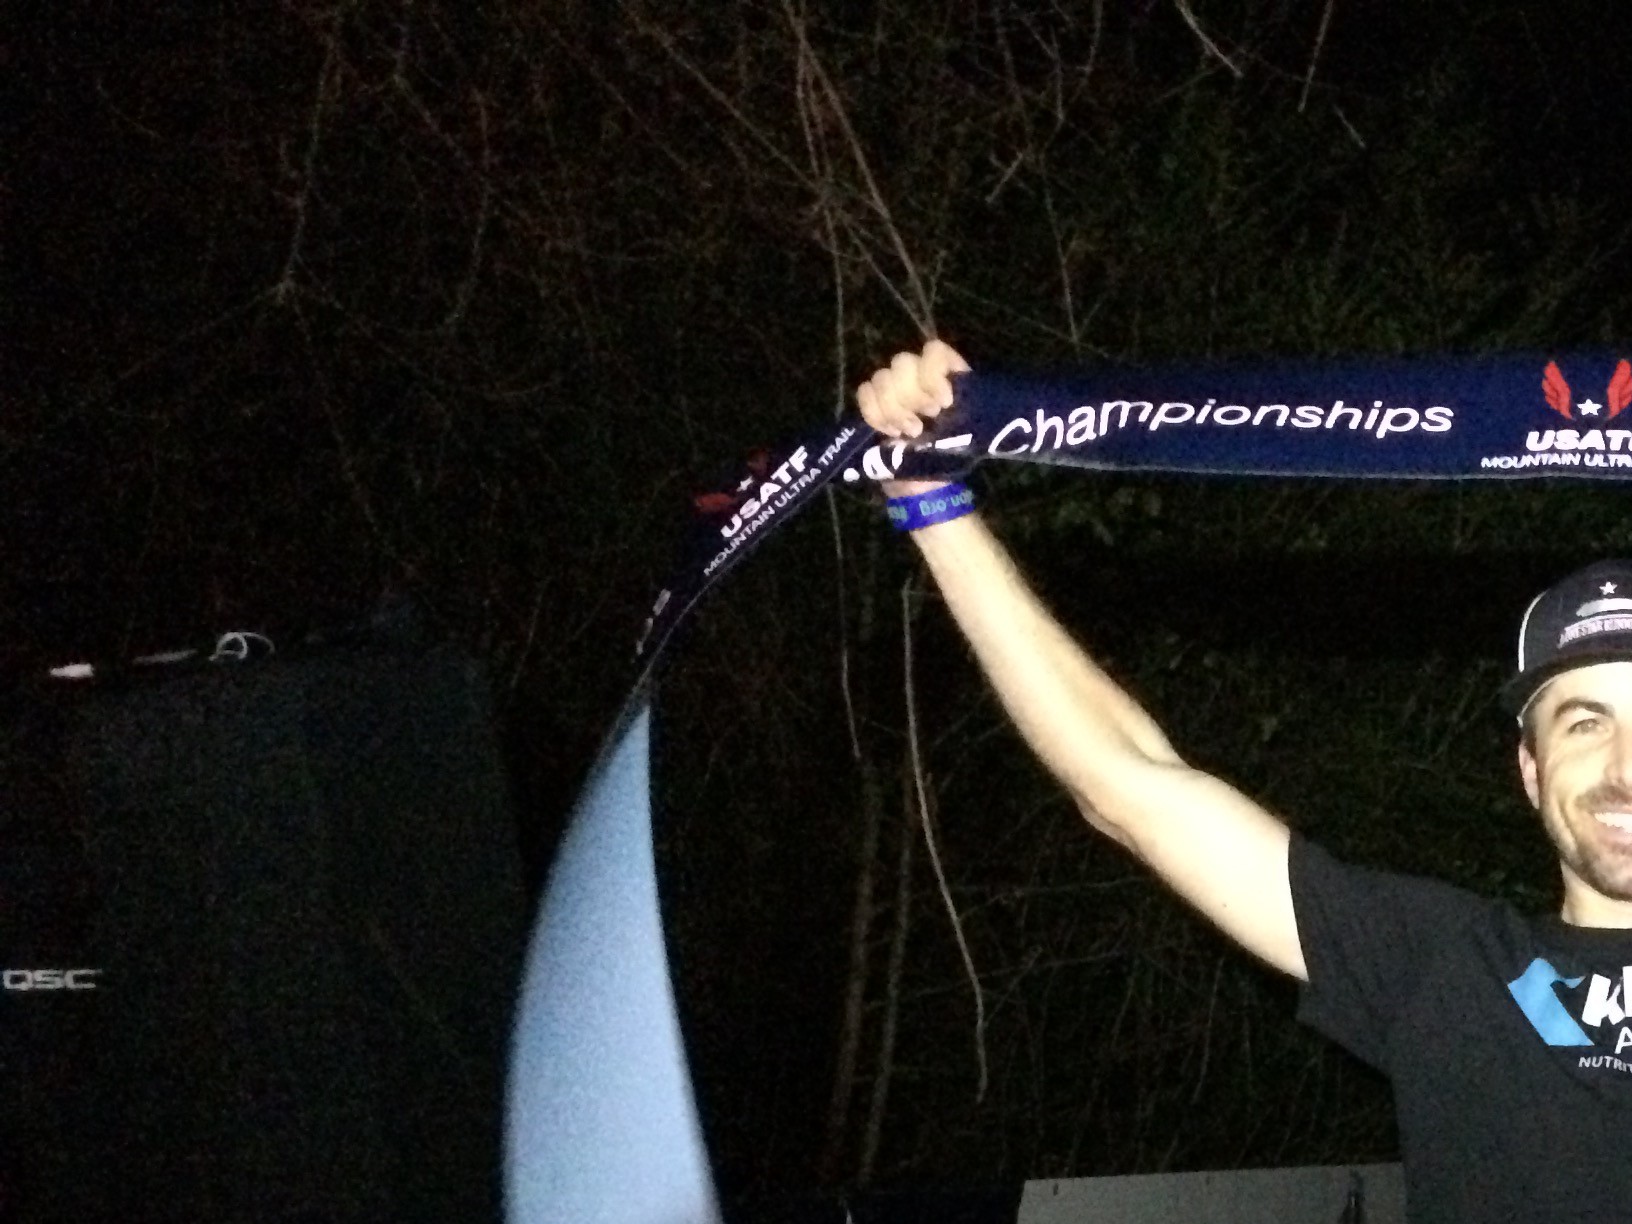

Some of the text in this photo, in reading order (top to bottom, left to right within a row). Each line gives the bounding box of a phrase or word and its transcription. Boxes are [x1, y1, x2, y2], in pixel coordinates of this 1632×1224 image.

[988, 399, 1455, 457] Championships
[1481, 452, 1581, 470] MOUNTAIN
[703, 505, 776, 576] MOUNTAIN
[774, 467, 822, 508] ULTRA
[818, 427, 857, 466] TRAIL
[720, 445, 808, 538] USATF
[3, 969, 102, 991] QSC
